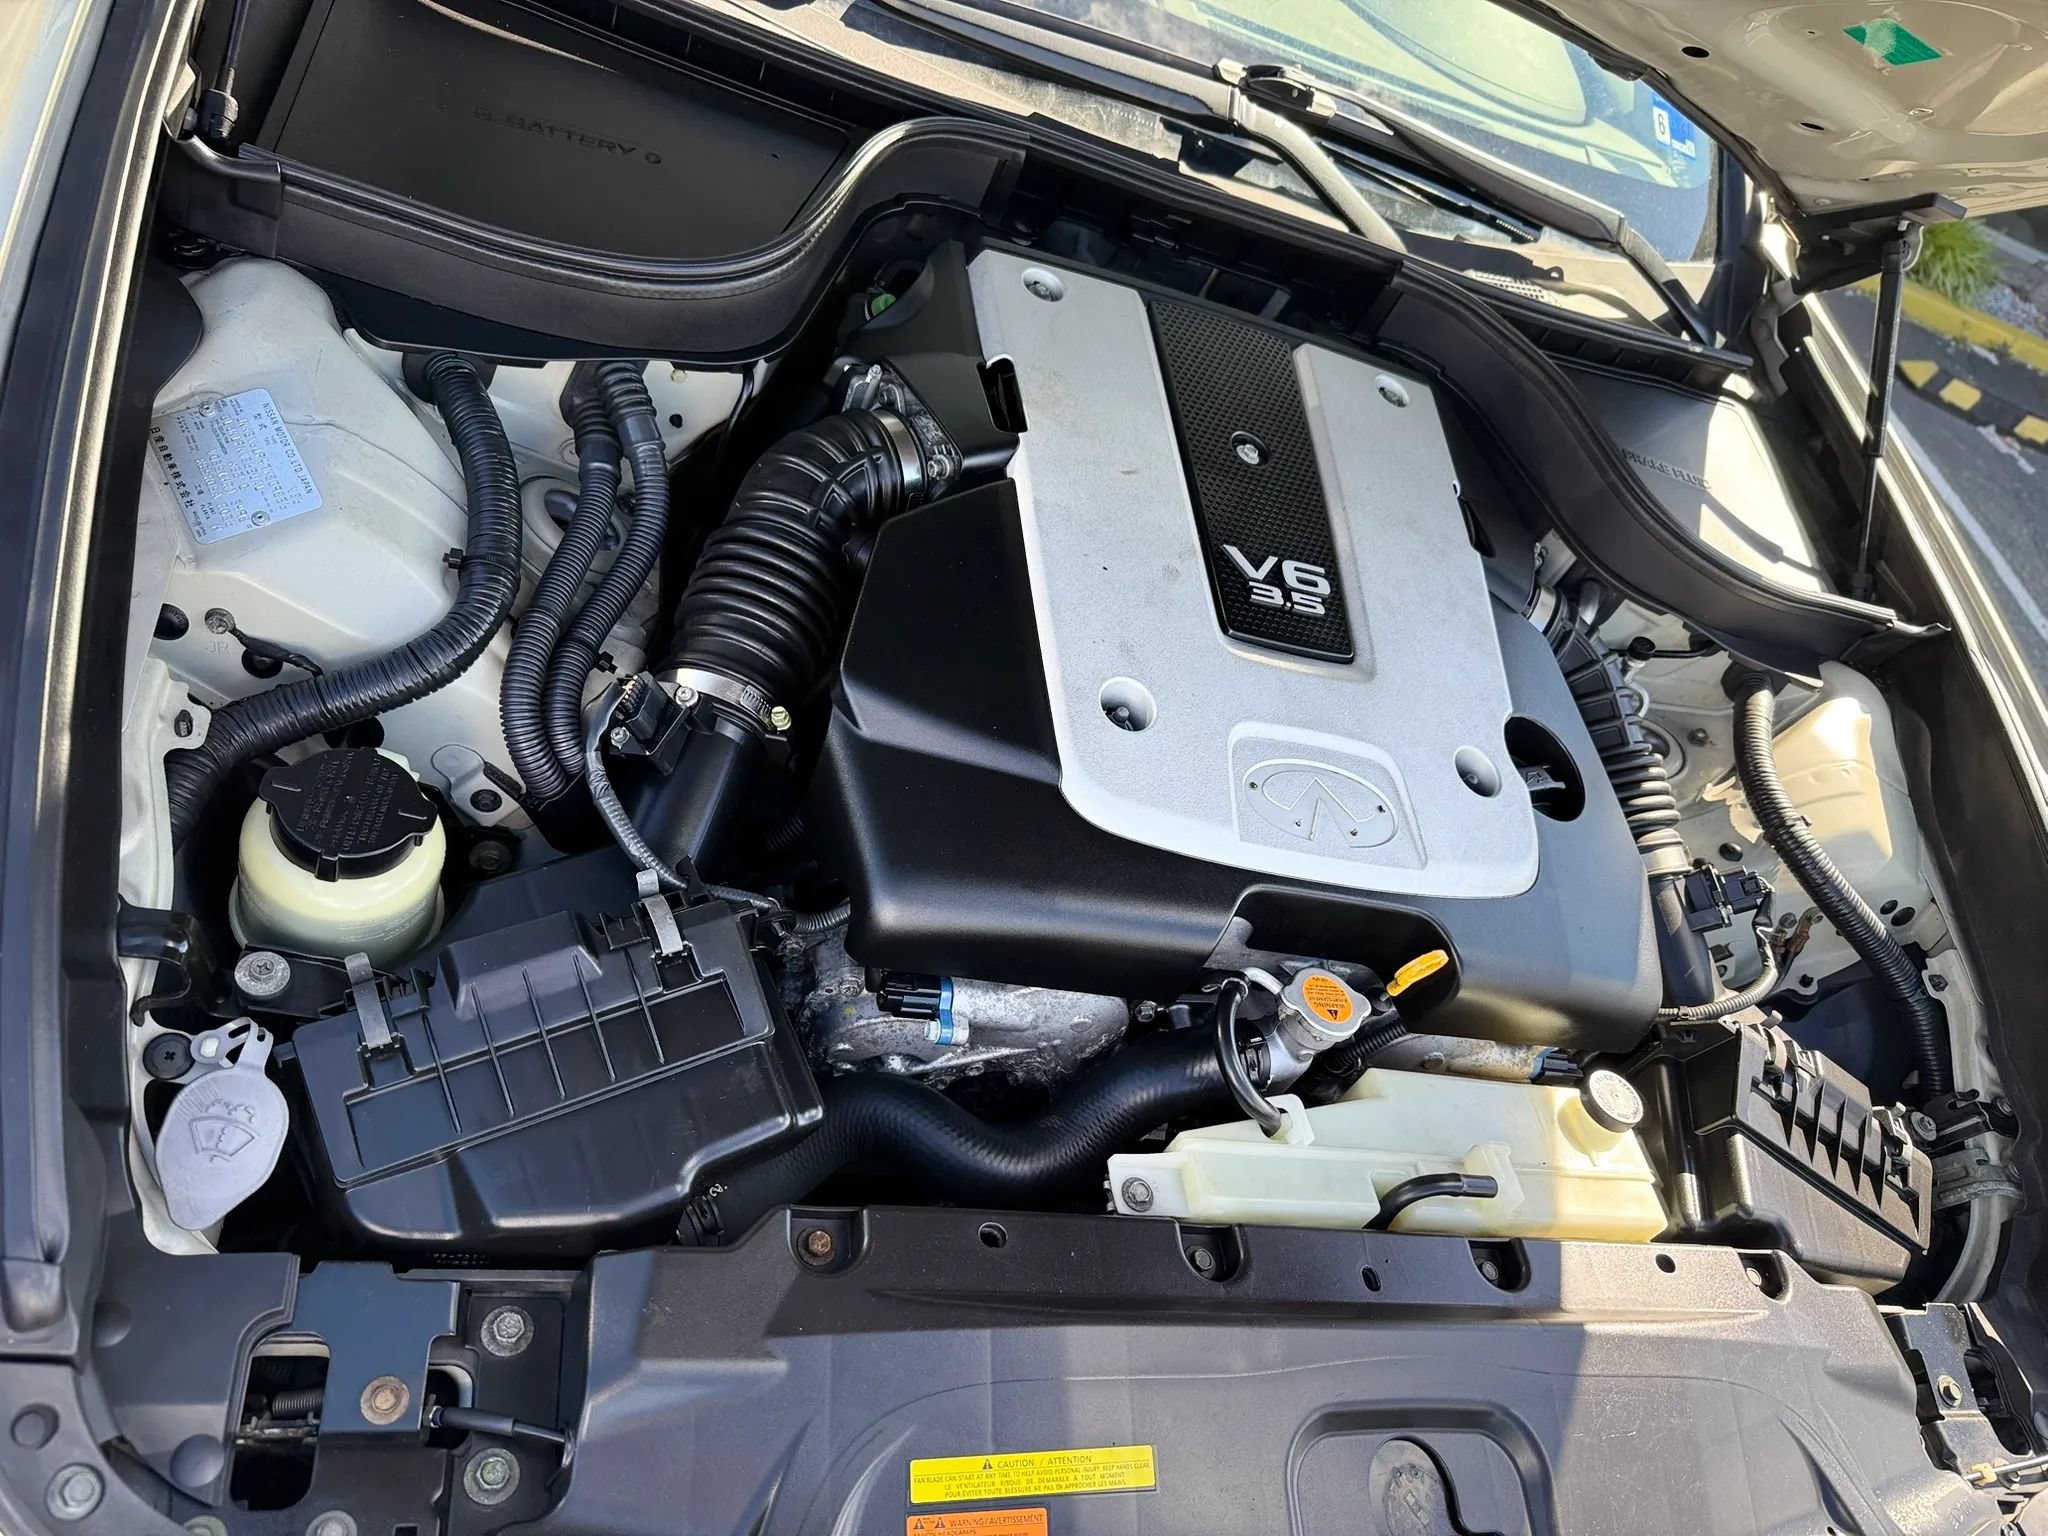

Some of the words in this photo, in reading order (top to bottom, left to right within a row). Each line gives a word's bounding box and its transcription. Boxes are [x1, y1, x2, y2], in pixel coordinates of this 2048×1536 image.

[1657, 113, 1666, 135] 6
[262, 402, 279, 426] NISSAN
[274, 425, 291, 447] MOTOR
[1221, 543, 1331, 597] V6
[1248, 580, 1326, 616] 3.5
[997, 1458, 1035, 1469] CAUTION
[1047, 1455, 1092, 1466] ATTENTION
[926, 1476, 944, 1484] BLADE
[958, 1474, 975, 1482] START
[956, 1481, 995, 1490] VENTILATEUR
[944, 1490, 961, 1498] POUR
[983, 1487, 1002, 1495] TOUTE
[1064, 1480, 1096, 1489] APPROCHER
[988, 1514, 1043, 1526] AVERTISSEMENT
